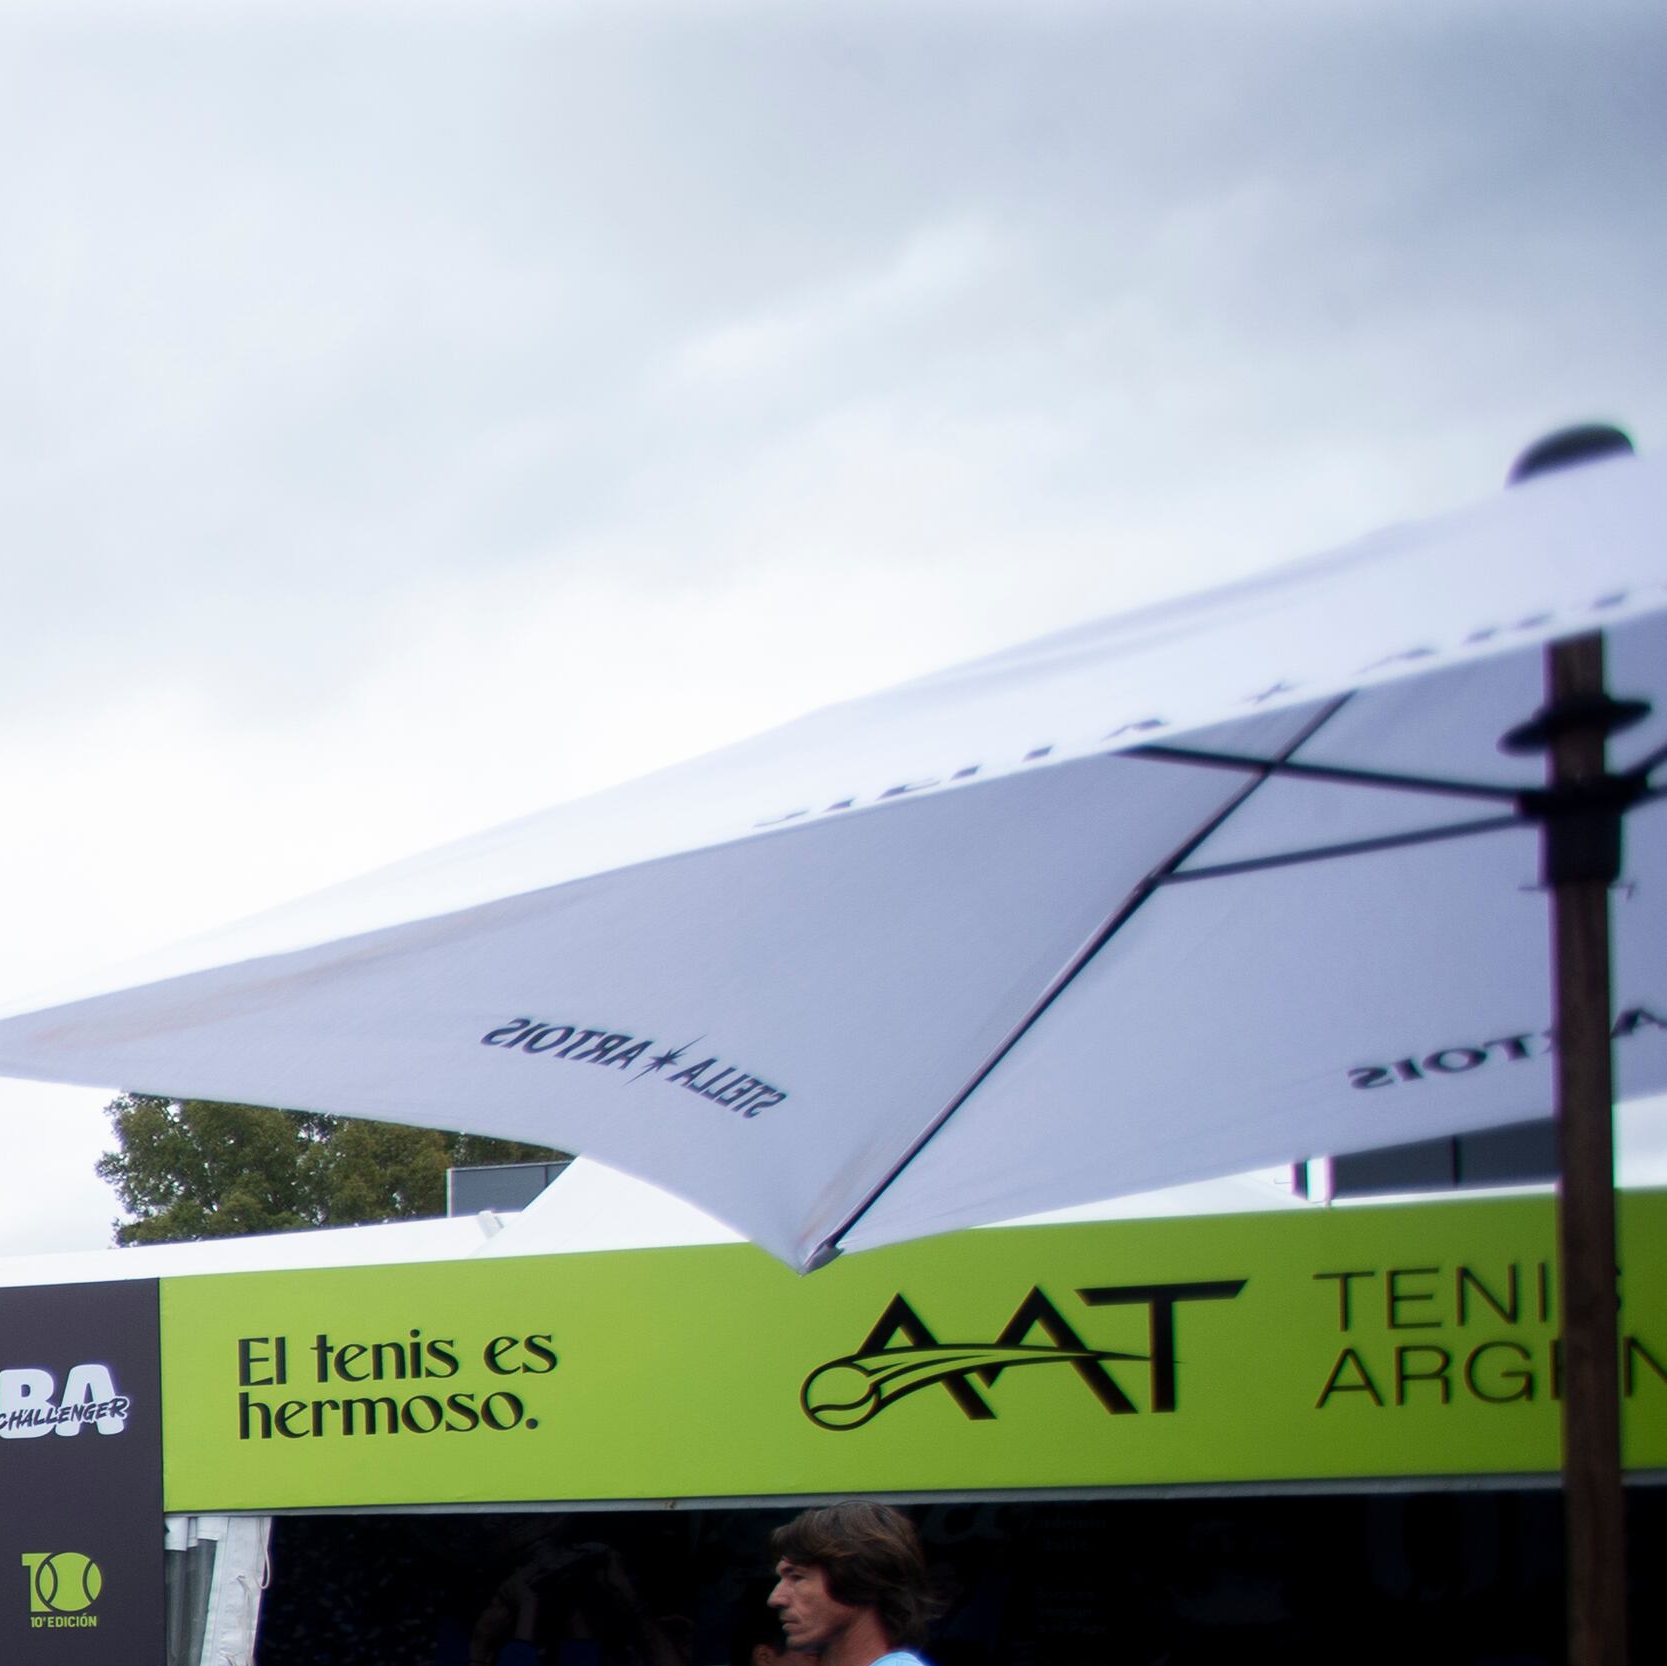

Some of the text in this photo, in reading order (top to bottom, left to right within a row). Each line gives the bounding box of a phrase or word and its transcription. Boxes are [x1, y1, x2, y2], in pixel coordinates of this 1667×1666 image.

[1313, 1262, 1622, 1332] TENI
[238, 1329, 558, 1387] El tenis es
[801, 1279, 1249, 1431] AAT
[239, 1391, 539, 1440] hermoso.
[48, 1613, 97, 1628] EDICIÓN
